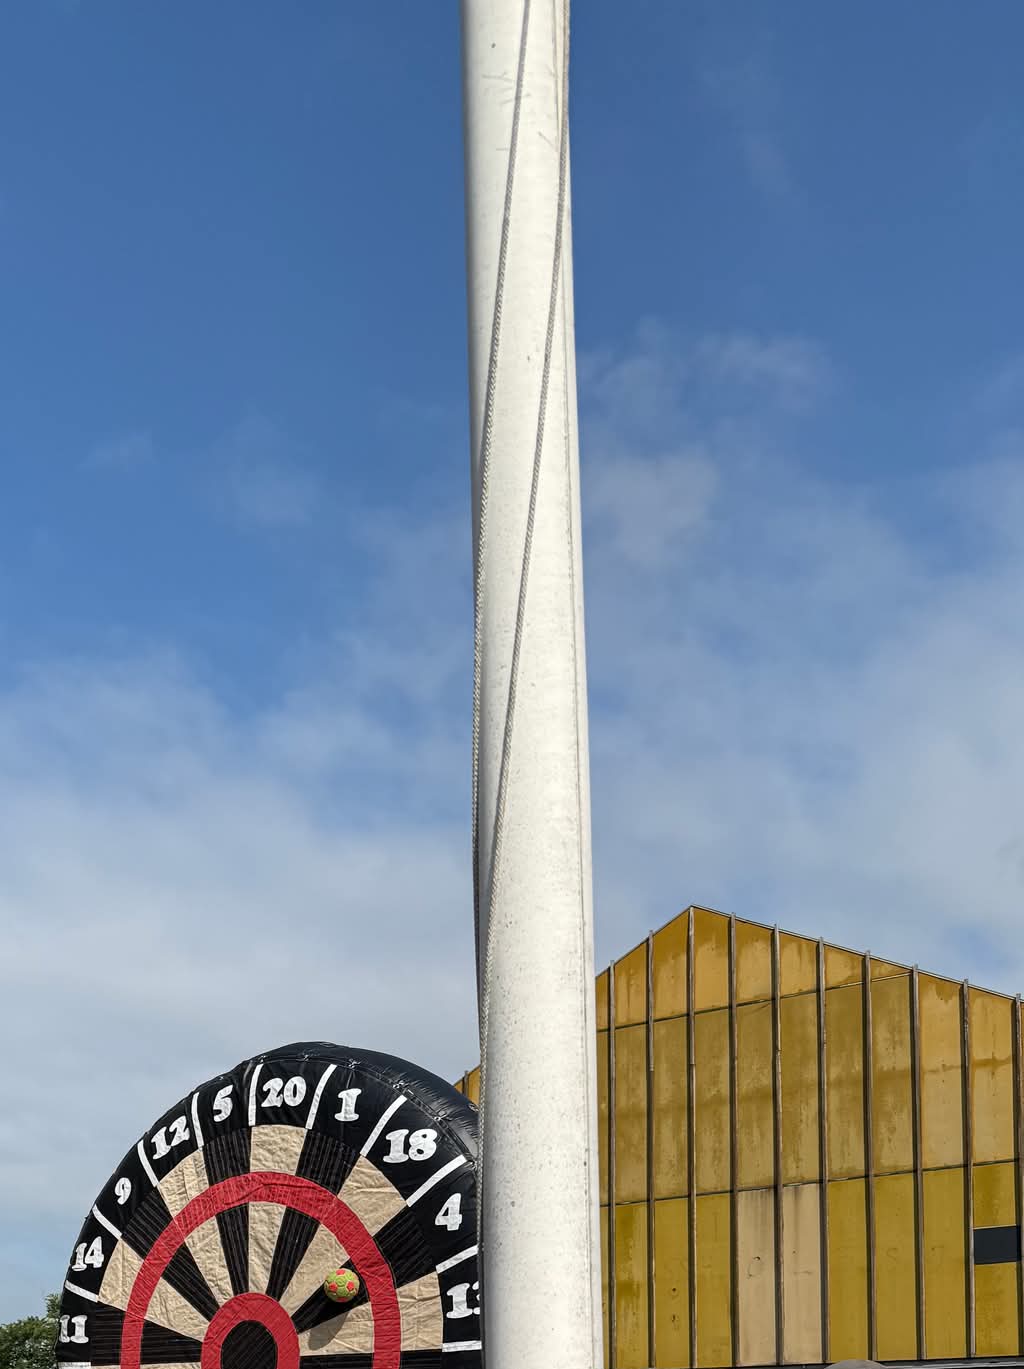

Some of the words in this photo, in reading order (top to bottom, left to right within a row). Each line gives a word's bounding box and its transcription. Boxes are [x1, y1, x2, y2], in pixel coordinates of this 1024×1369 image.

[213, 1084, 236, 1122] 5
[261, 1076, 307, 1109] 20
[337, 1088, 362, 1122] 1
[151, 1115, 191, 1161] 12
[382, 1128, 439, 1164] 18
[114, 1177, 132, 1205] 9
[434, 1192, 463, 1231] 4
[72, 1236, 104, 1271] 14
[446, 1282, 480, 1319] 1
[59, 1315, 89, 1344] 11
